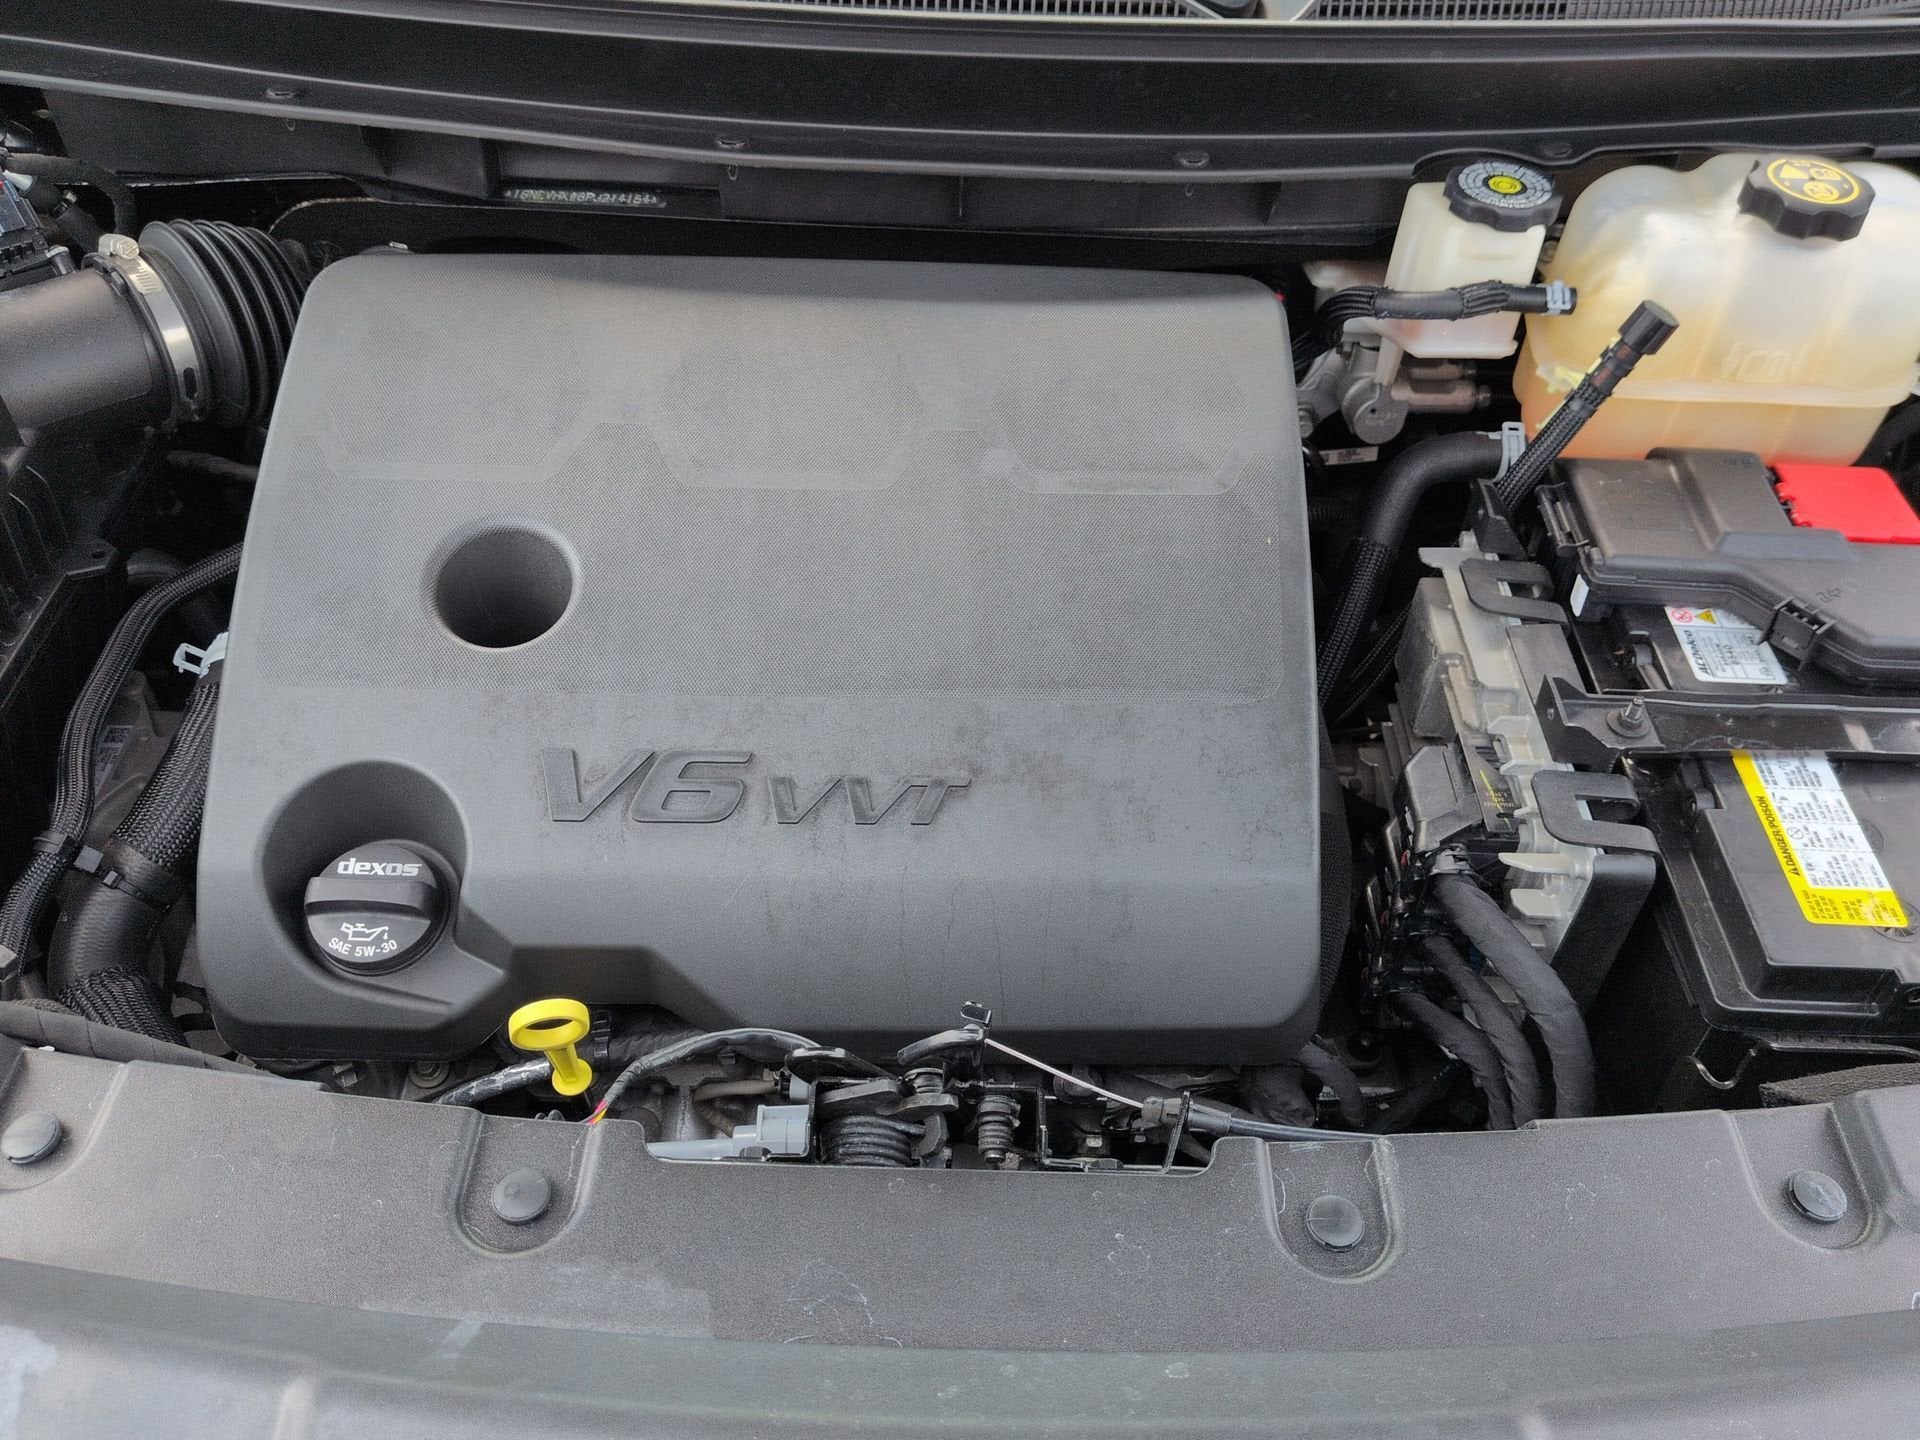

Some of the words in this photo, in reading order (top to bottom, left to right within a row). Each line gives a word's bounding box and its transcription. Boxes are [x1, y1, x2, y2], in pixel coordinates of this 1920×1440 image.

[542, 749, 752, 823] V6
[768, 775, 971, 825] VVT
[1756, 795, 1796, 867] DANGER/POISON
[337, 857, 423, 877] dexos
[328, 937, 352, 955] SAE
[354, 939, 398, 957] 5W-30
